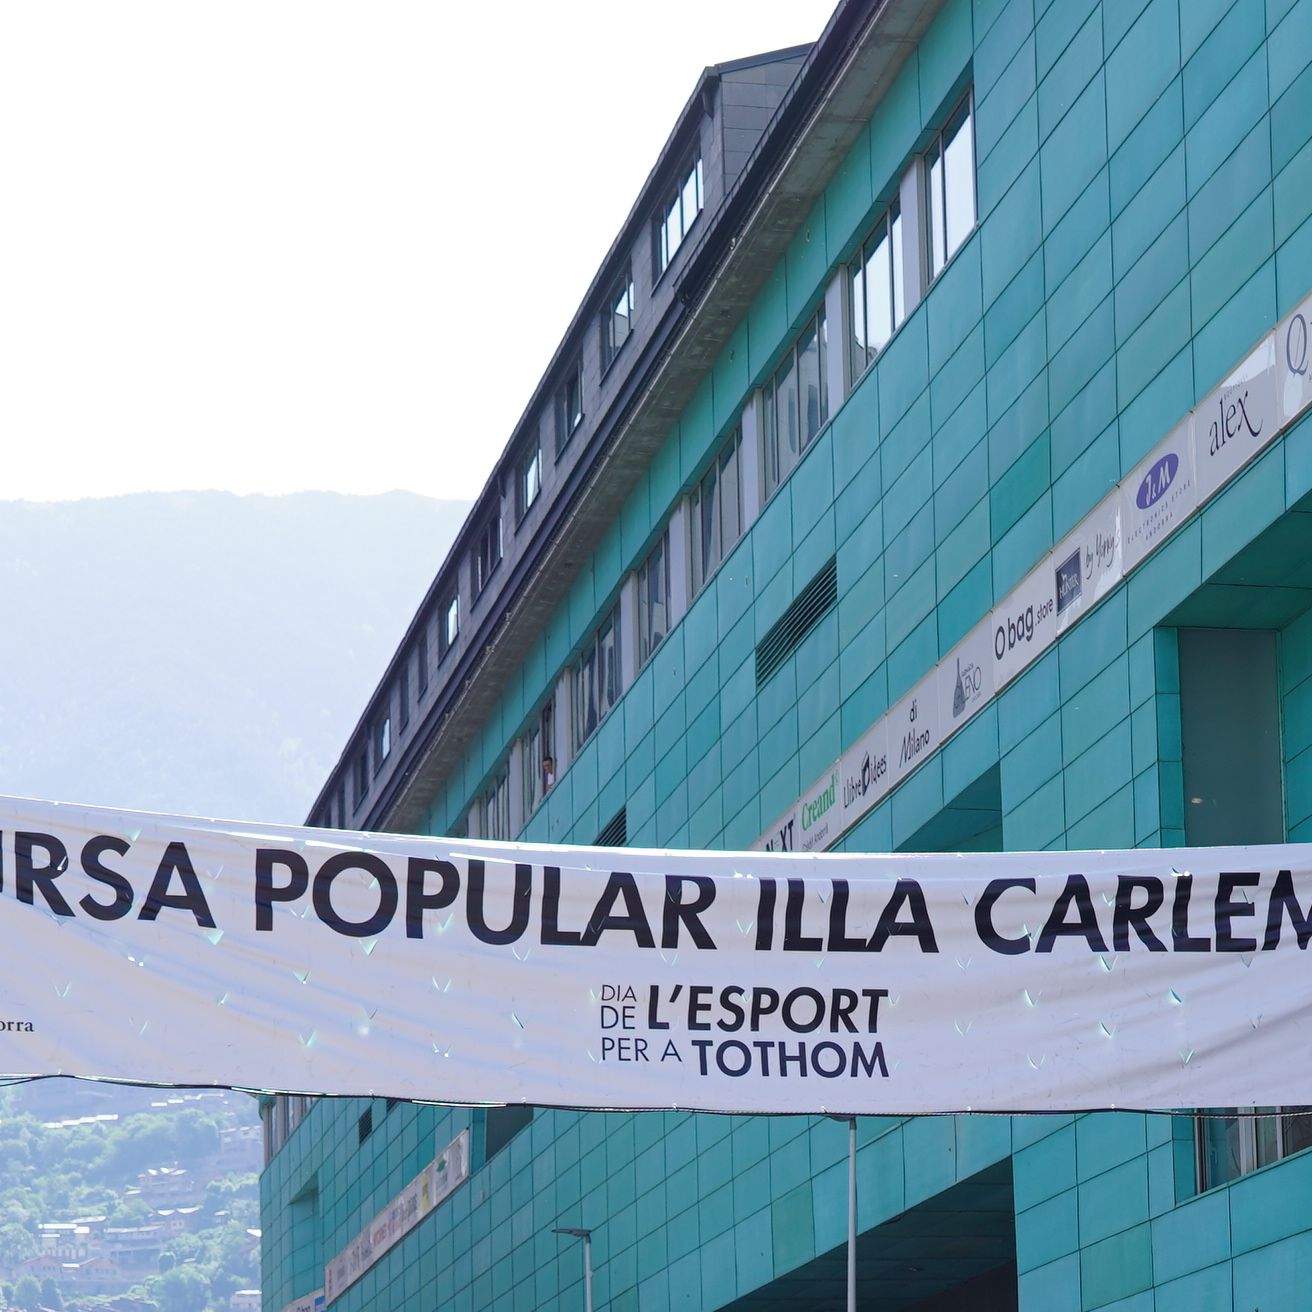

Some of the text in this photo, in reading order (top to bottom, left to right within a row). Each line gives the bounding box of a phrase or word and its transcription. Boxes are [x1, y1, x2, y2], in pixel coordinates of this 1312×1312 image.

[1209, 391, 1263, 457] alex
[899, 728, 930, 769] Milano
[801, 772, 835, 832] Creand
[254, 848, 718, 950] POPULAR
[755, 879, 940, 954] ILLA
[600, 984, 637, 1002] DIA
[600, 984, 889, 1034] DE L'ESPORT
[601, 1036, 890, 1079] PER A TOTHOM
